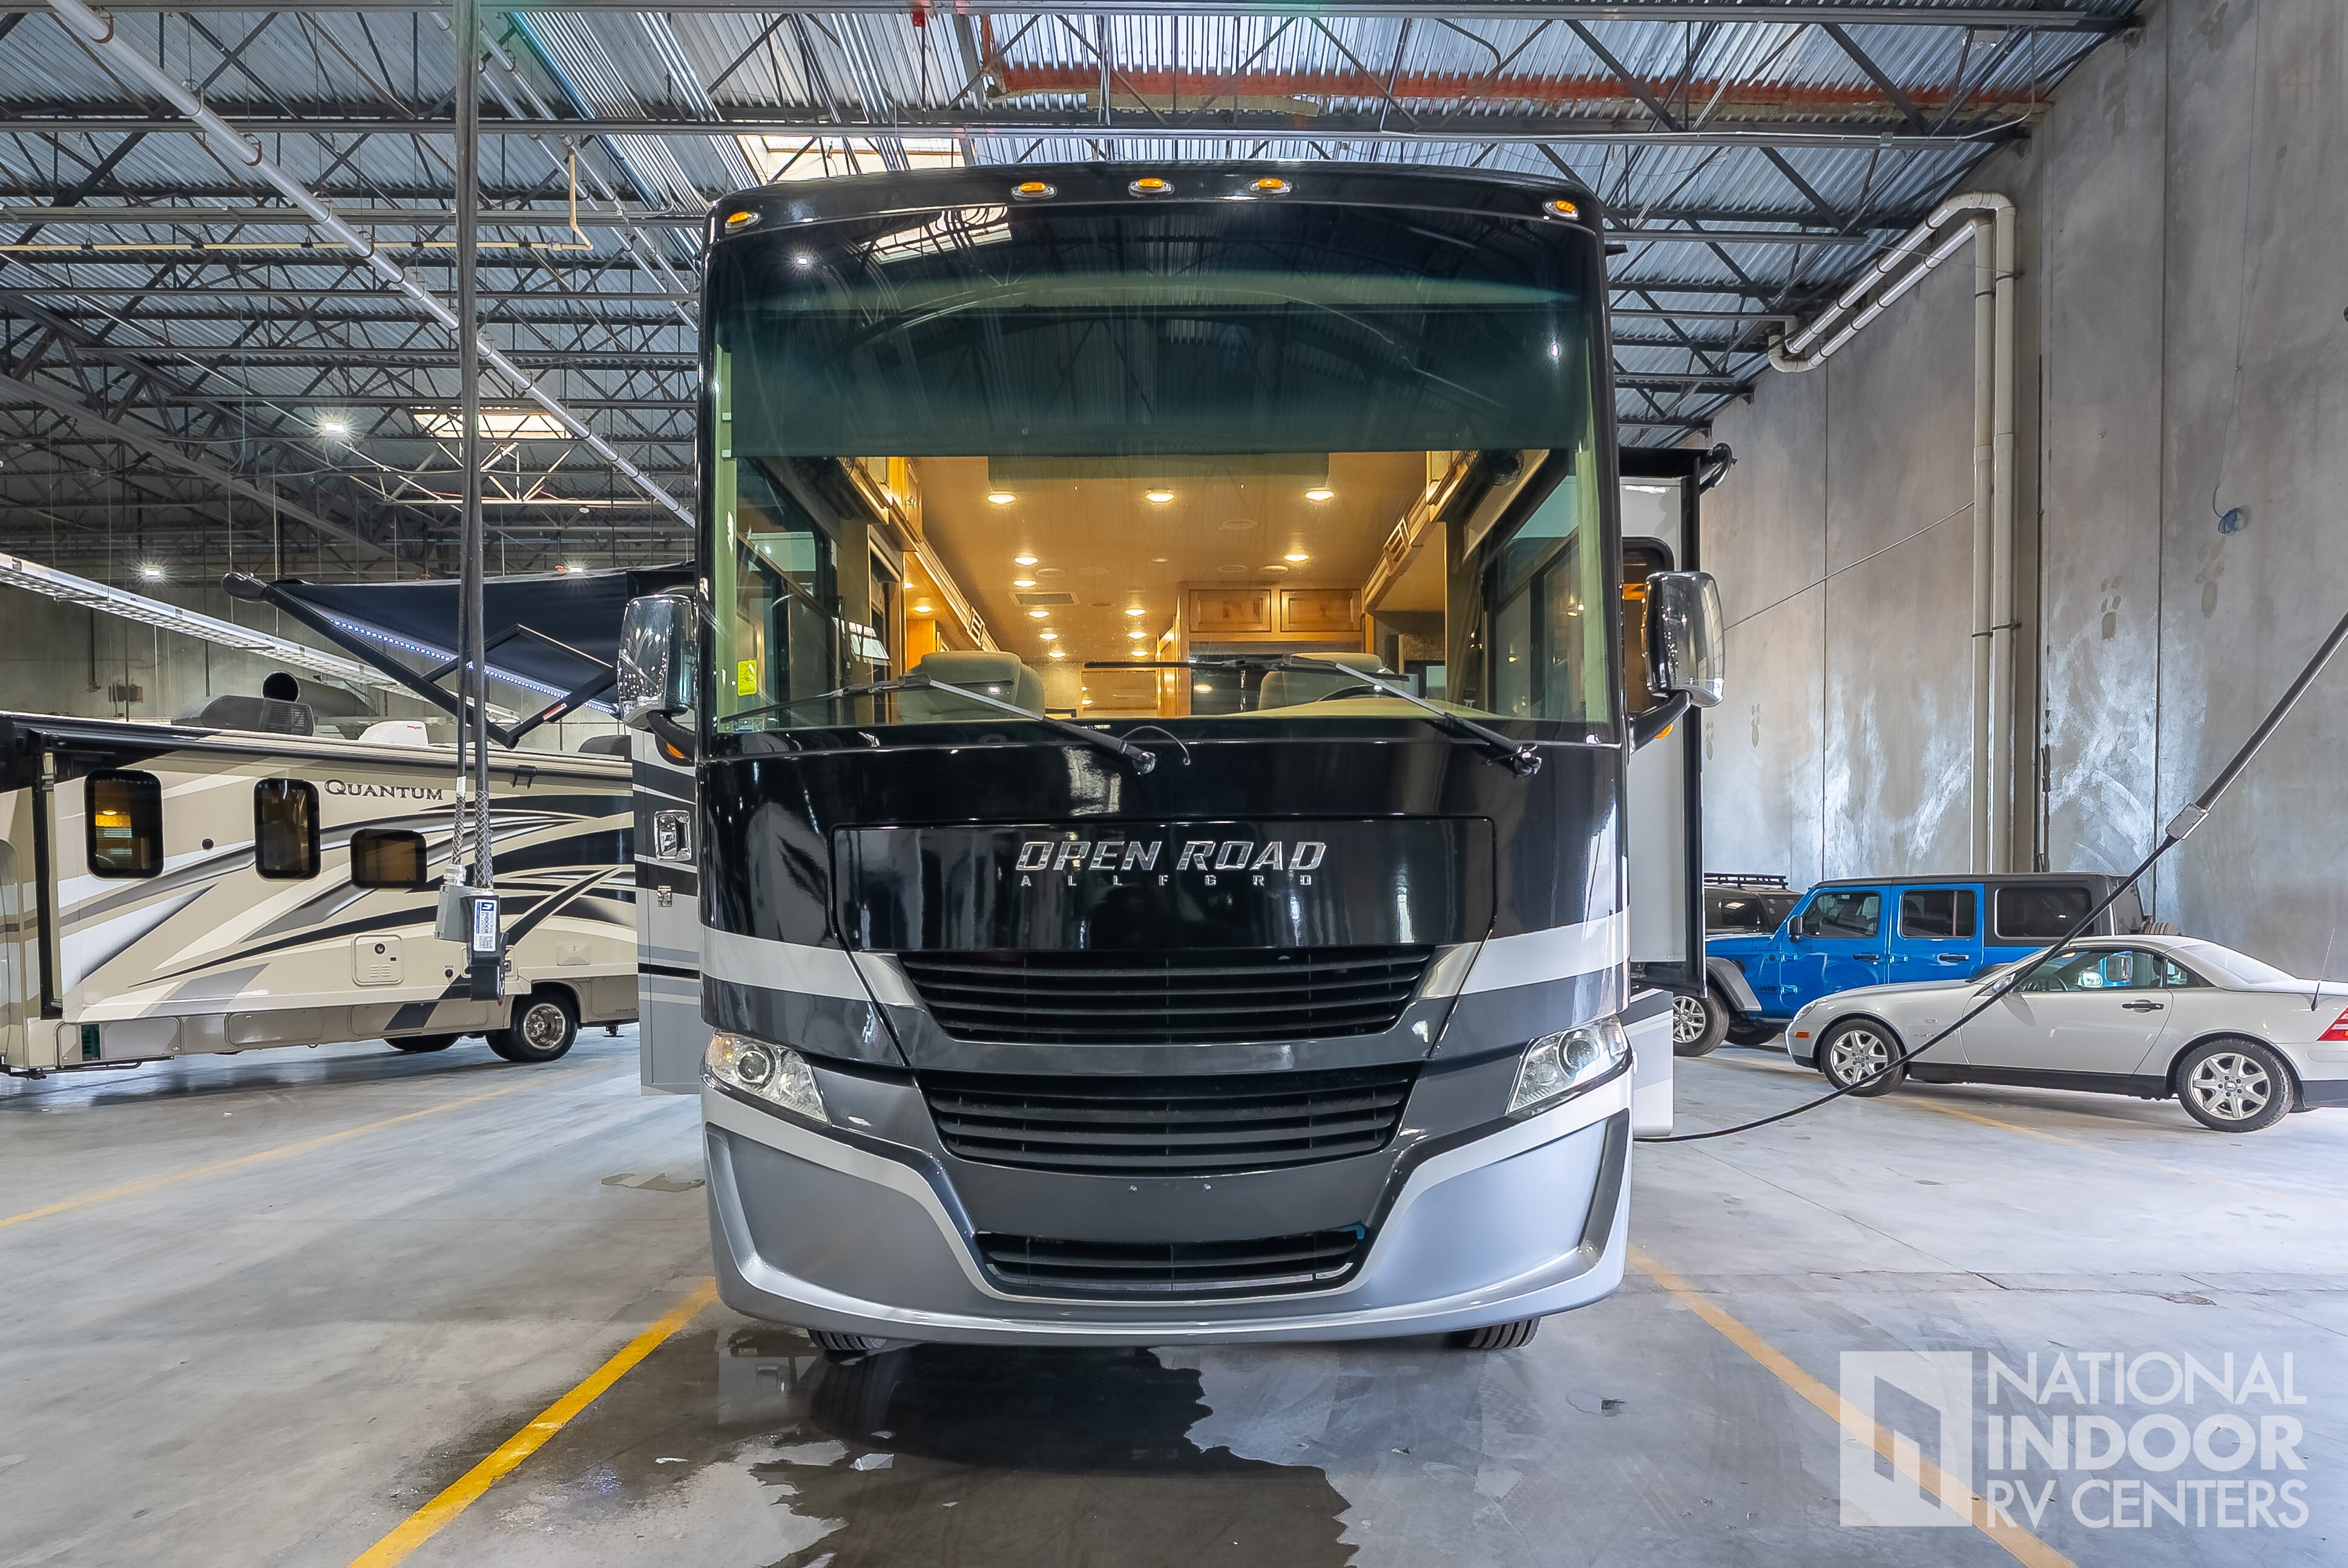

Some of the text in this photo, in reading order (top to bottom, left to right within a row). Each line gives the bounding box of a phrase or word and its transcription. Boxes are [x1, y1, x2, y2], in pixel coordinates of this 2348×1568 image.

[324, 779, 444, 801] QUANTUM
[1016, 841, 1326, 871] OPEN ROAD
